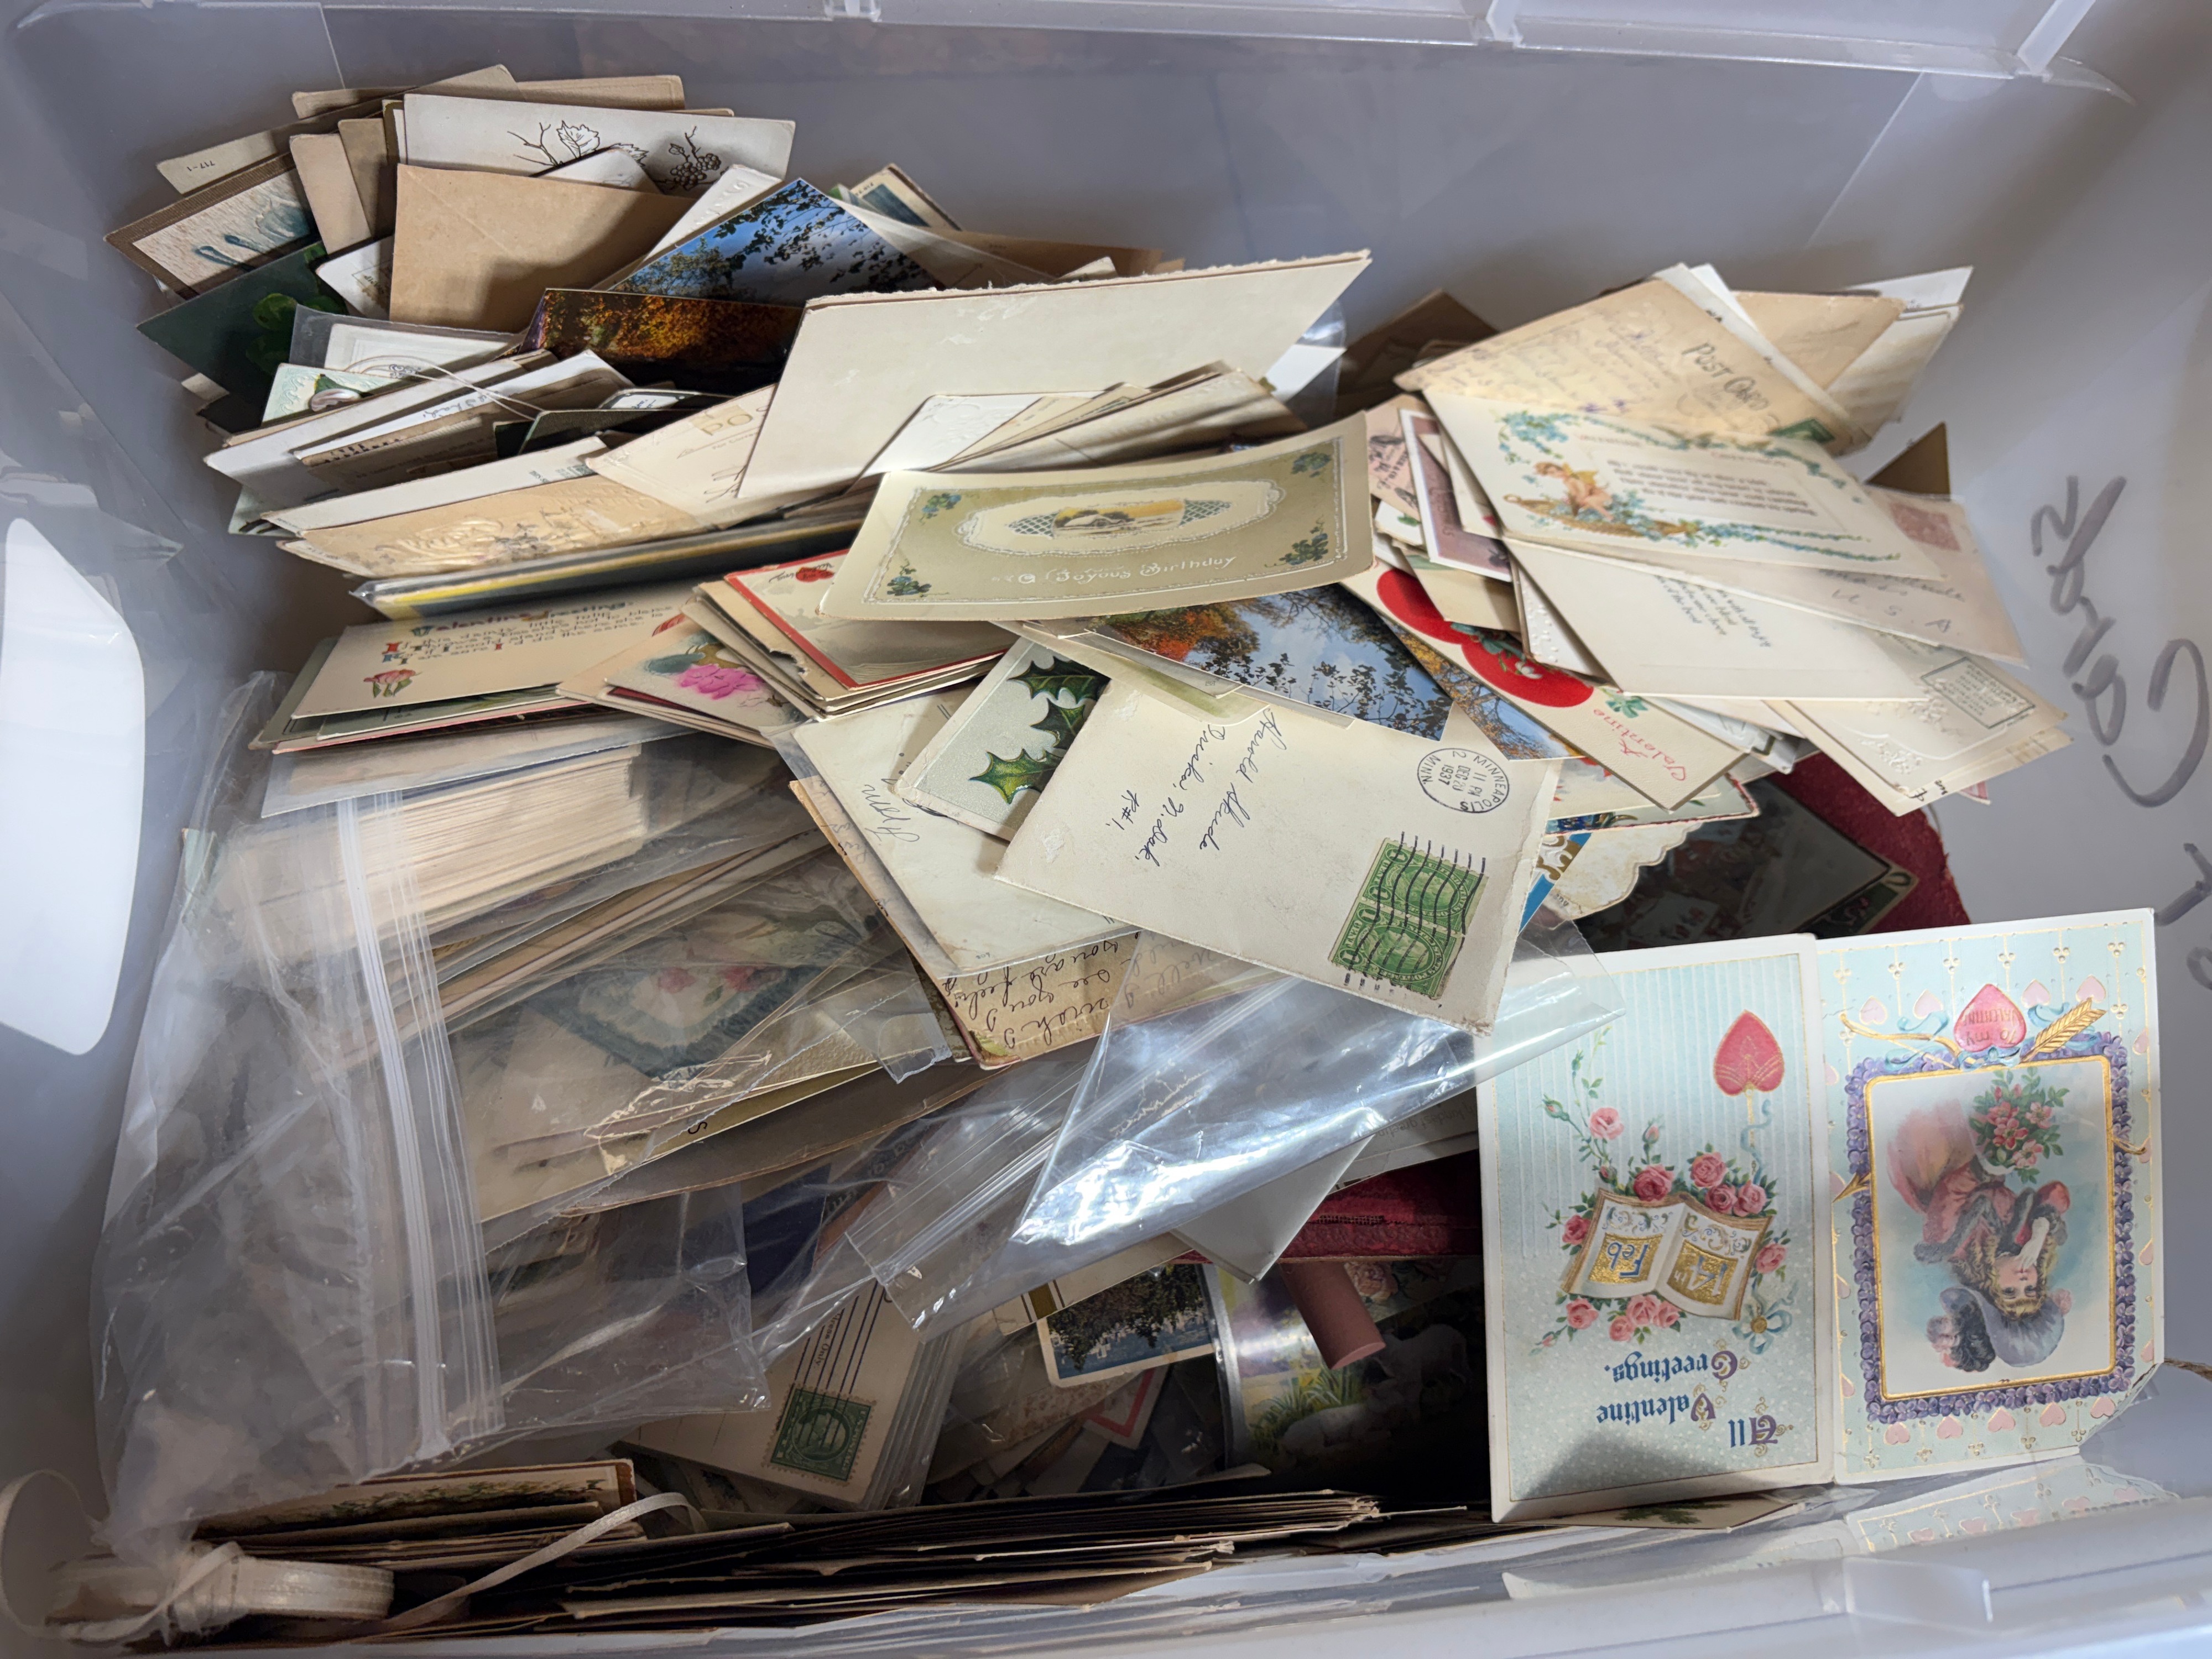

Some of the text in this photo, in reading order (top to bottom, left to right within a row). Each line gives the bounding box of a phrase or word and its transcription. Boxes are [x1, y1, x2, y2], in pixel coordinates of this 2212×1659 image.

[1045, 565, 1132, 585] Joyous
[1140, 556, 1237, 577] Birthday
[1593, 708, 1686, 781] Valentine
[1420, 754, 1442, 785] MINN.
[1438, 764, 1455, 786] 1937
[1455, 764, 1471, 781] DEC
[1459, 755, 1506, 812] MINNEAPOLIS
[1344, 920, 1363, 948] CENT
[1607, 1241, 1650, 1279] Feb
[1604, 1350, 1739, 1383] Greetings.
[1596, 1392, 1716, 1426] Valentine
